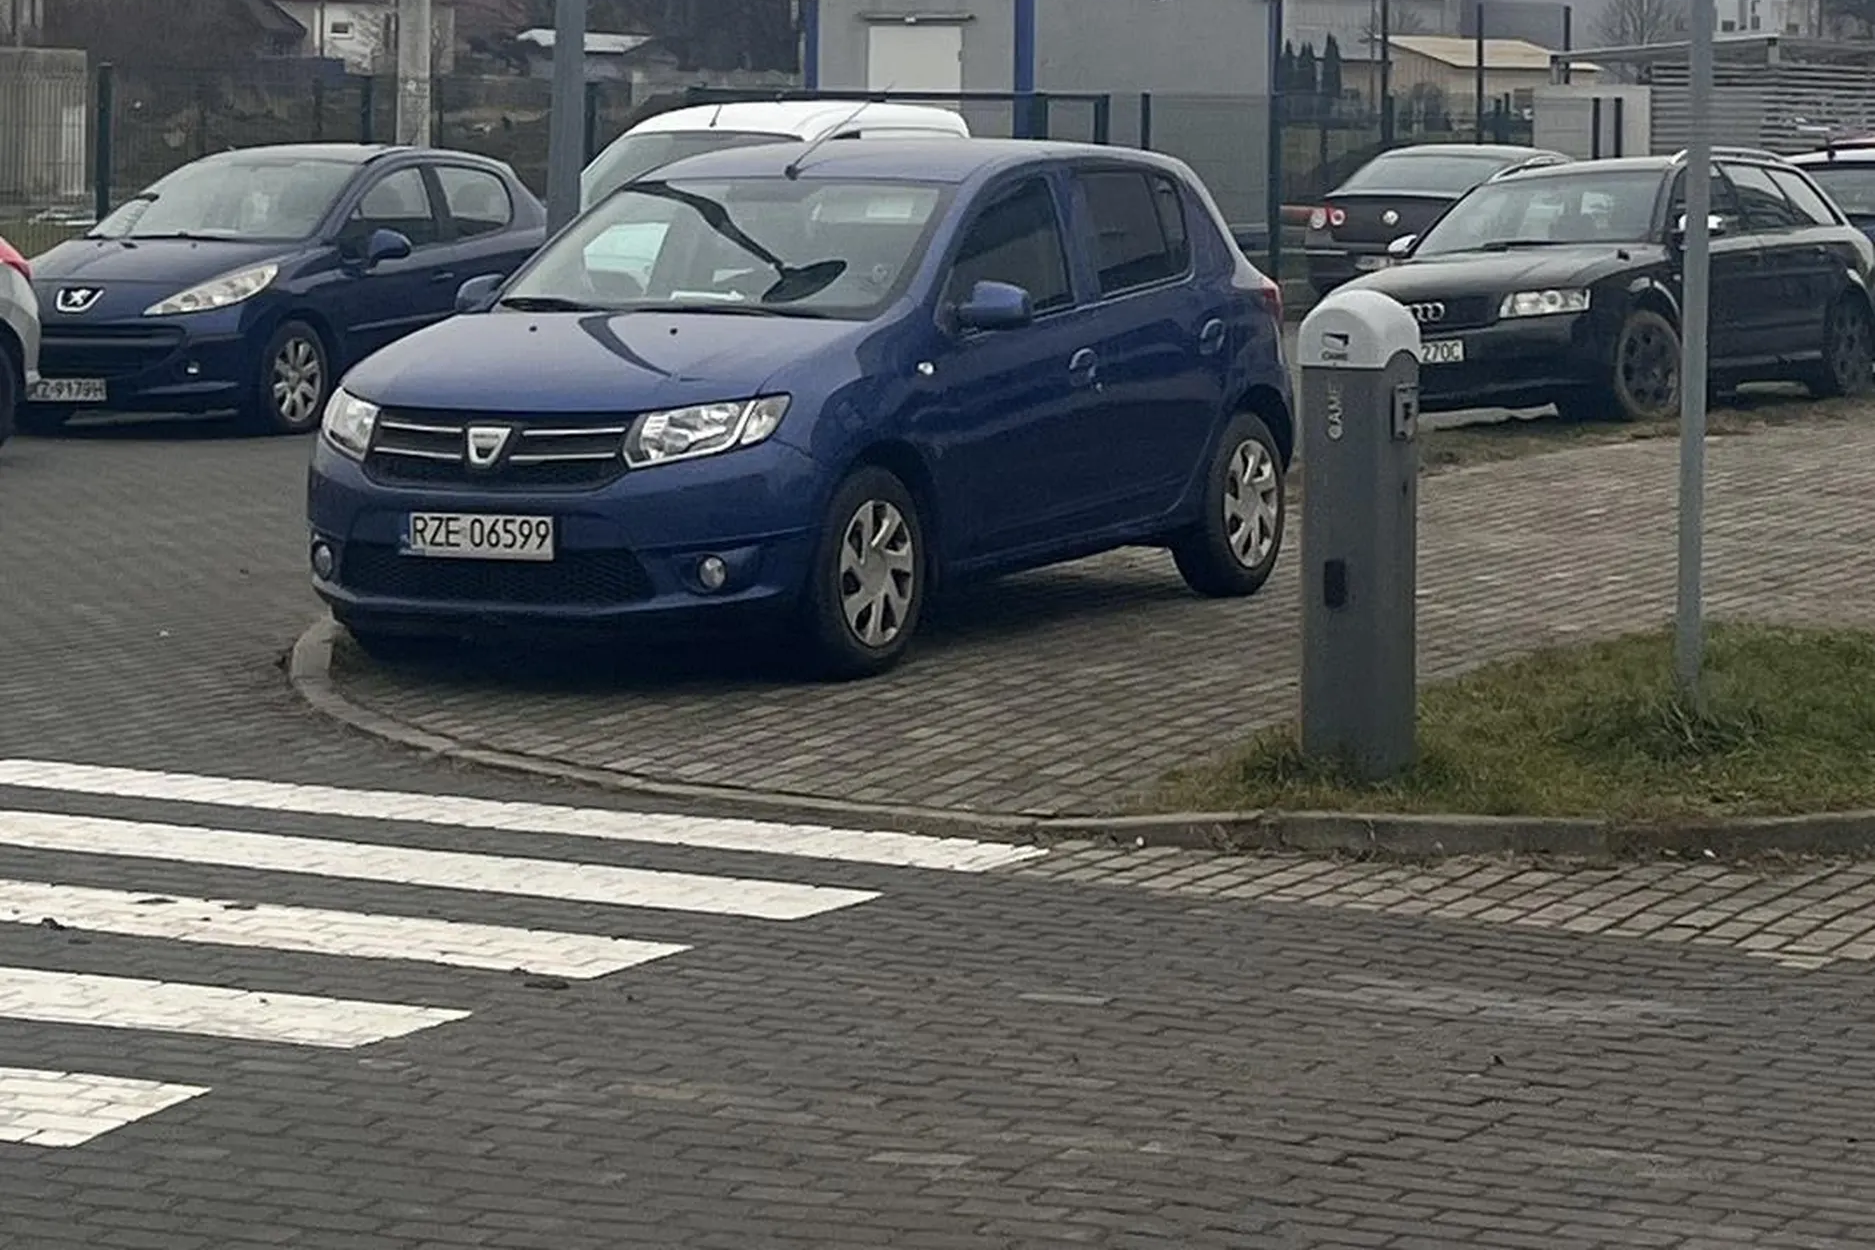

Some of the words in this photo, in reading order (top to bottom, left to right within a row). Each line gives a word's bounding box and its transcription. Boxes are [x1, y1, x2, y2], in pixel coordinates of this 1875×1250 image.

[1420, 342, 1460, 362] 270C
[412, 516, 461, 547] RZE
[470, 517, 552, 550] 06599
